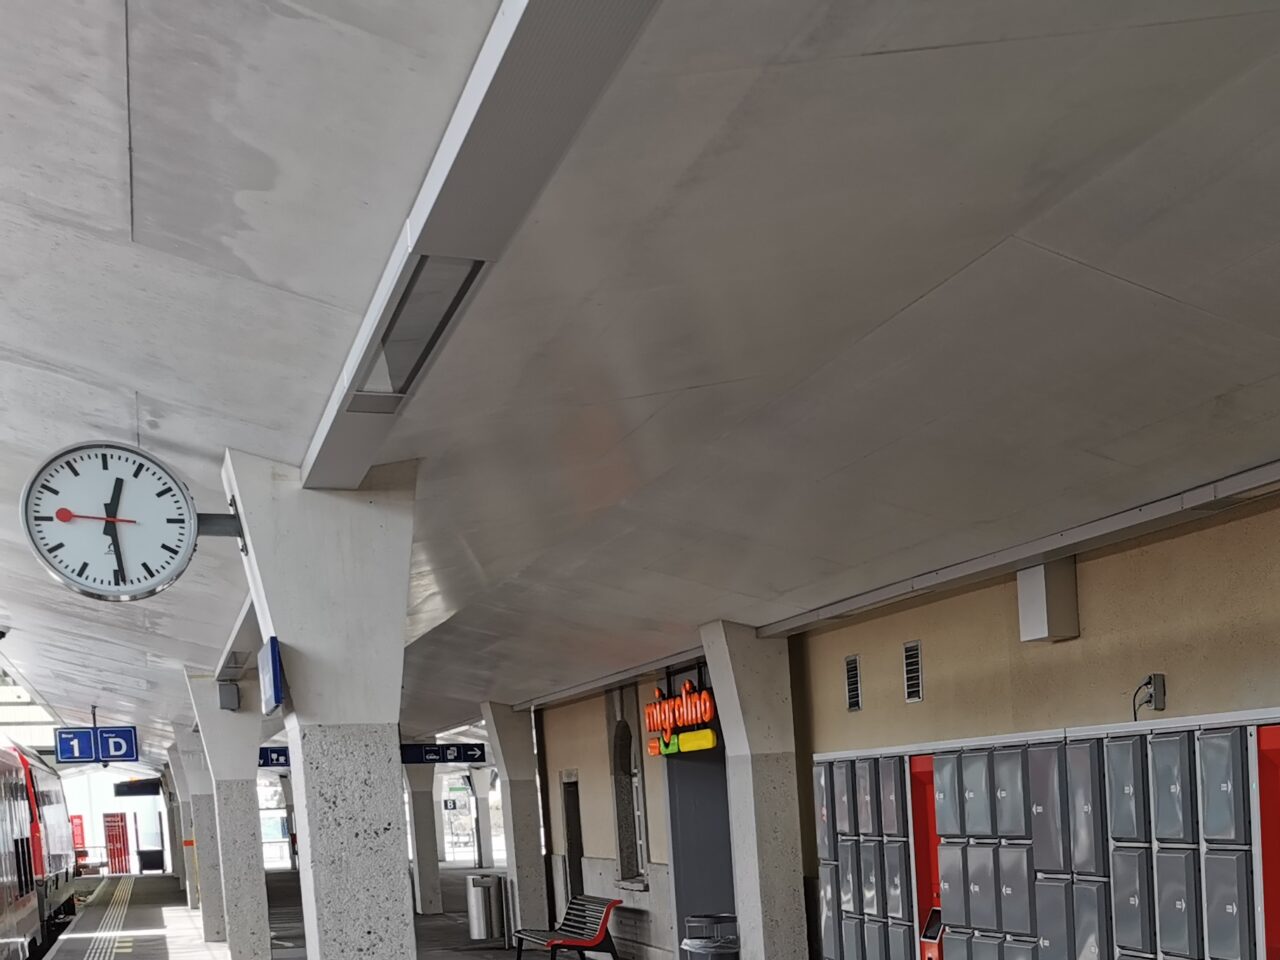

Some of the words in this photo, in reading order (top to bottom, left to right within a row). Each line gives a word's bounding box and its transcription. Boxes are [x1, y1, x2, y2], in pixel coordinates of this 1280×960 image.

[644, 679, 714, 743] migrolino
[70, 739, 80, 757] 1
[108, 738, 127, 756] D
